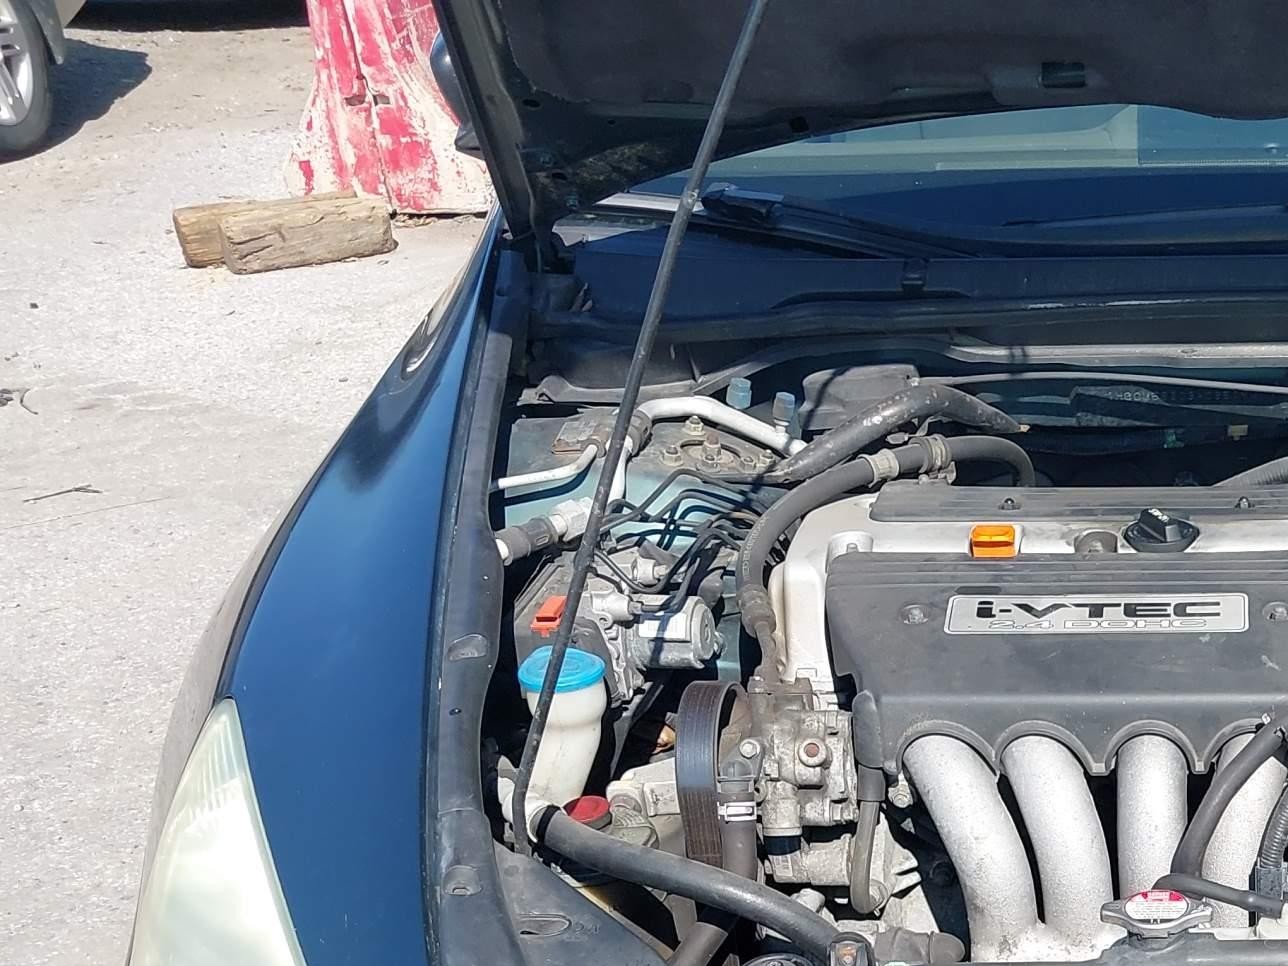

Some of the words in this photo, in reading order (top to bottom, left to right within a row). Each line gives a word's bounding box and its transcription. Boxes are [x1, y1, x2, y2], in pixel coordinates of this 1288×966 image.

[976, 600, 1221, 620] i-VTEC
[988, 619, 1054, 630] 2.4
[1063, 619, 1207, 630] DOHC
